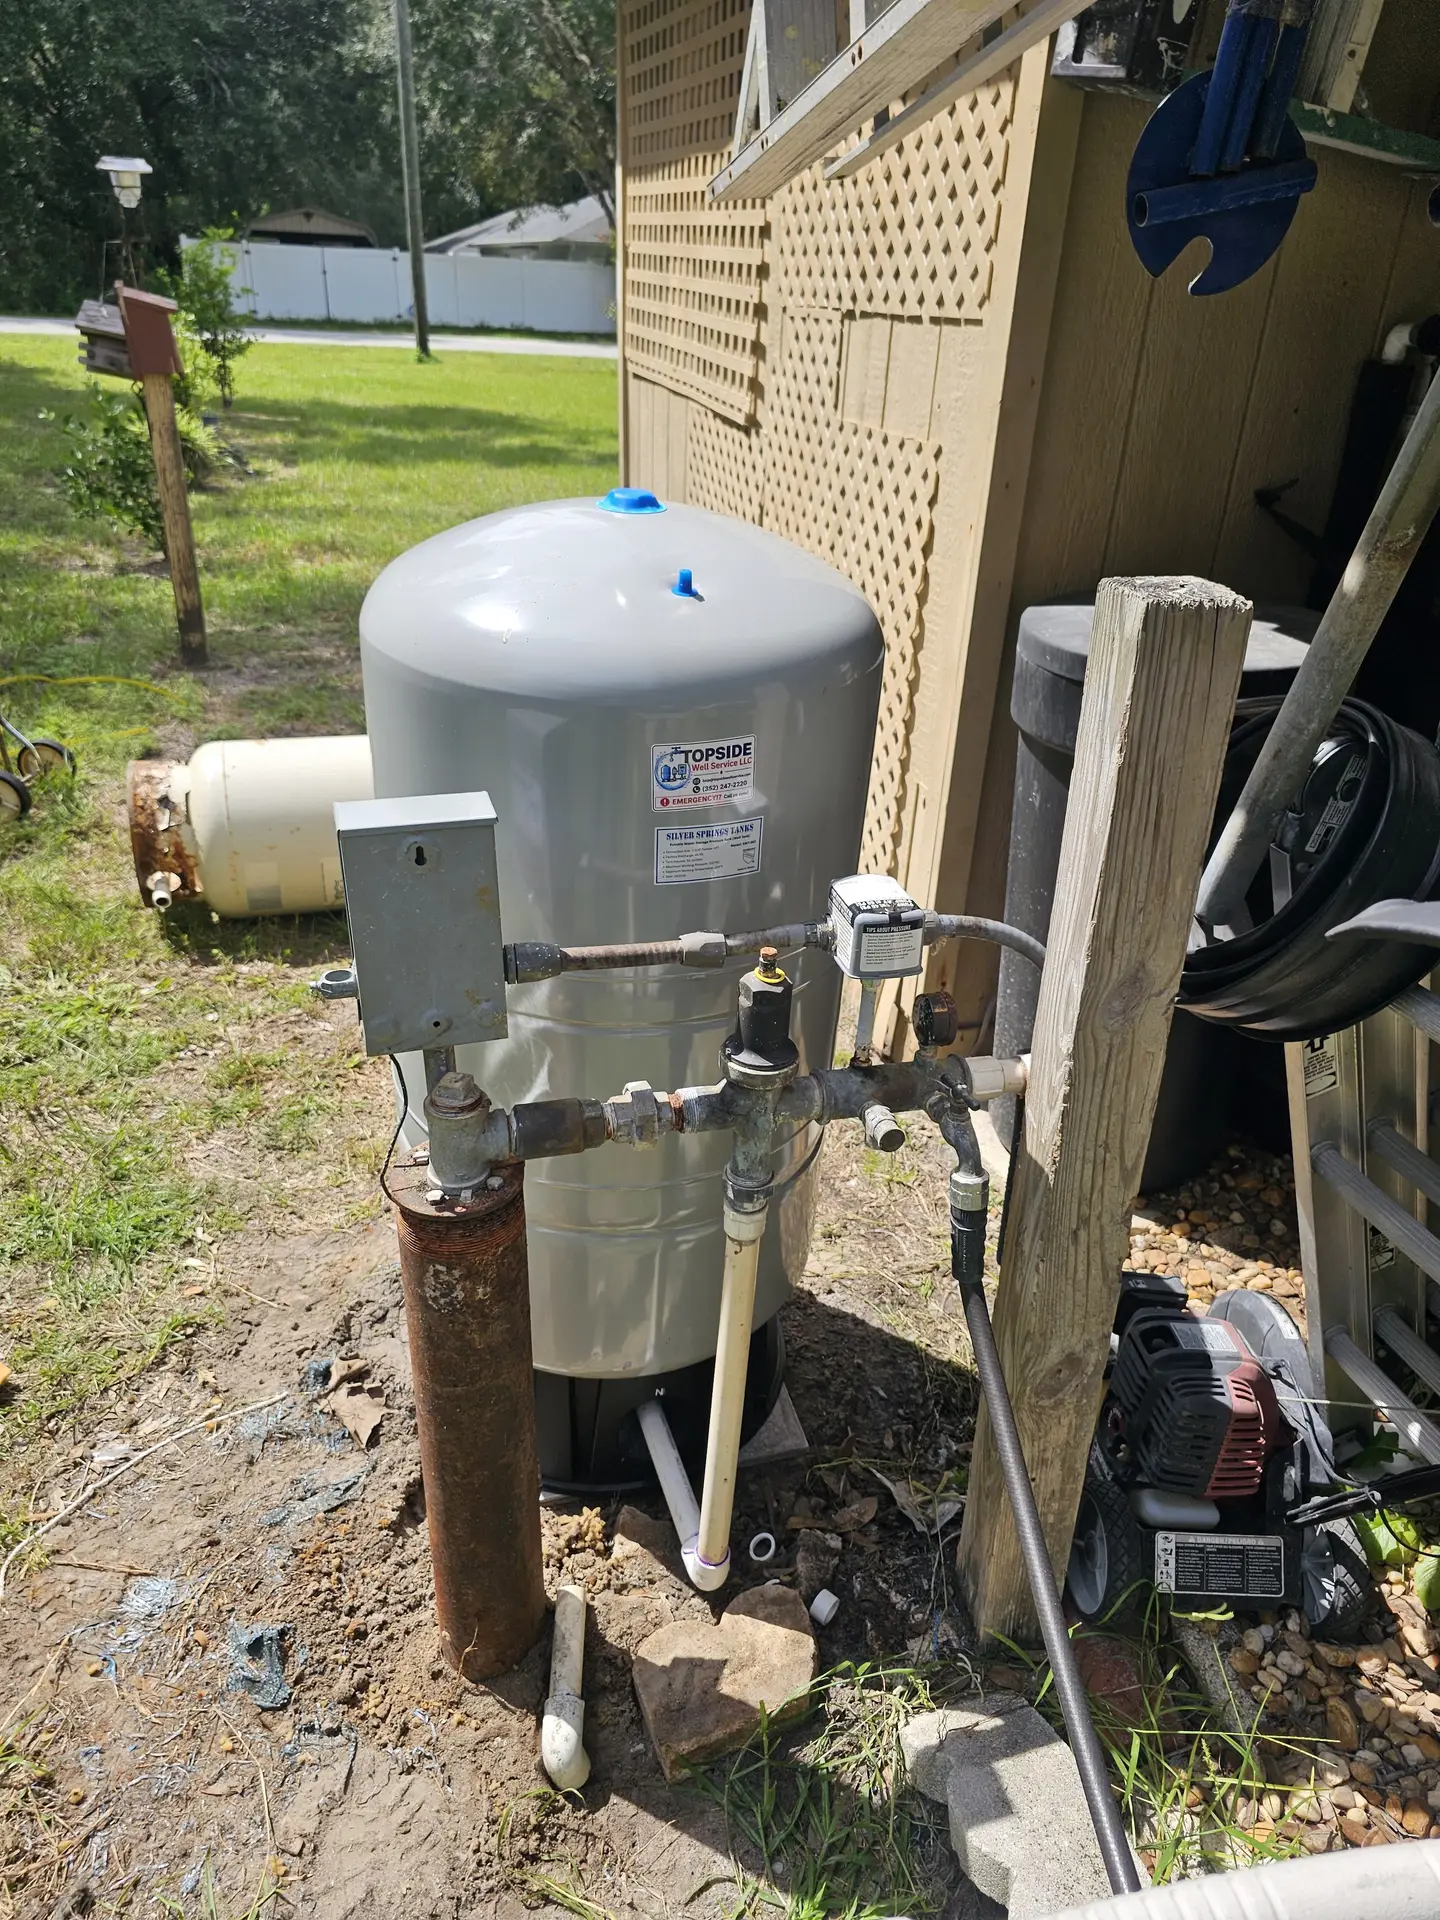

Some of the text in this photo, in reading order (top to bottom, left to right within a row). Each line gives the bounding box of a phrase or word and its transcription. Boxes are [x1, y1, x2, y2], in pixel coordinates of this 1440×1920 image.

[681, 742, 752, 763] TOPSIDE
[692, 757, 752, 772] Well Service LLC
[720, 780, 747, 789] 247-2220
[666, 824, 754, 840] SILVER SPRINGS TANKS
